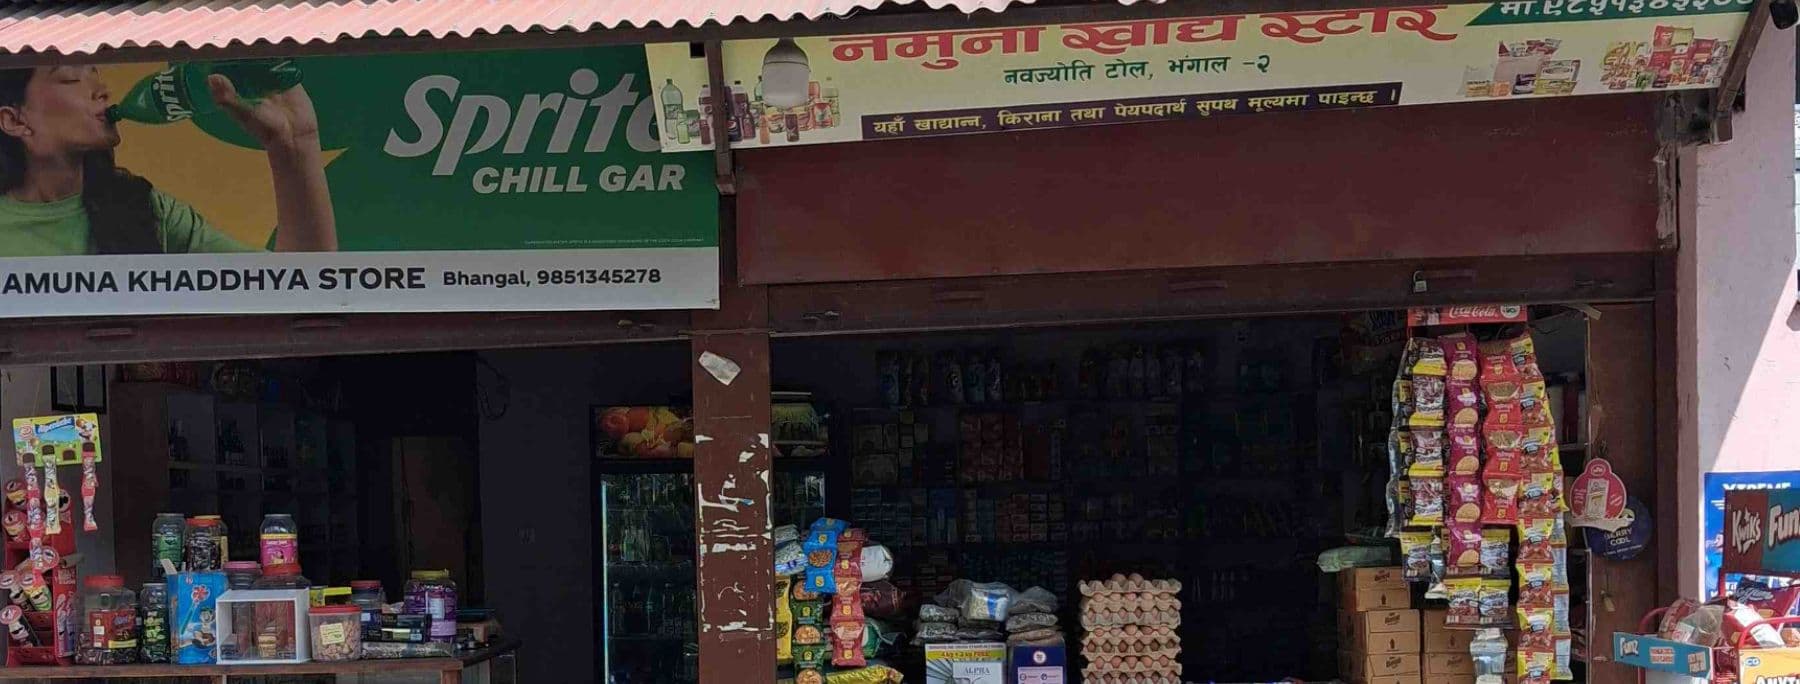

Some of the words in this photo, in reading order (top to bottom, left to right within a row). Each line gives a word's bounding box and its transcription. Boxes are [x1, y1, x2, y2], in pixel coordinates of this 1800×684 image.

[829, 26, 1046, 69] नमुना
[1003, 59, 1096, 84] नवज्योति
[1168, 54, 1231, 75] भंगाल
[873, 114, 906, 134] यहाँ
[997, 109, 1062, 128] किराना
[1070, 106, 1106, 122] तथा
[1114, 97, 1186, 118] पेयपदार्थ
[1196, 97, 1238, 117] सुपथ
[1247, 93, 1309, 112] मूल्यमा
[1318, 90, 1378, 106] पाइन्छ
[472, 165, 588, 194] CHILL
[599, 164, 686, 193] GAR
[2, 270, 118, 294] AMUNA
[128, 268, 309, 292] KHADDHYA
[318, 267, 426, 290] STORE
[443, 270, 531, 288] Bhangal,
[537, 268, 661, 285] 9851345278
